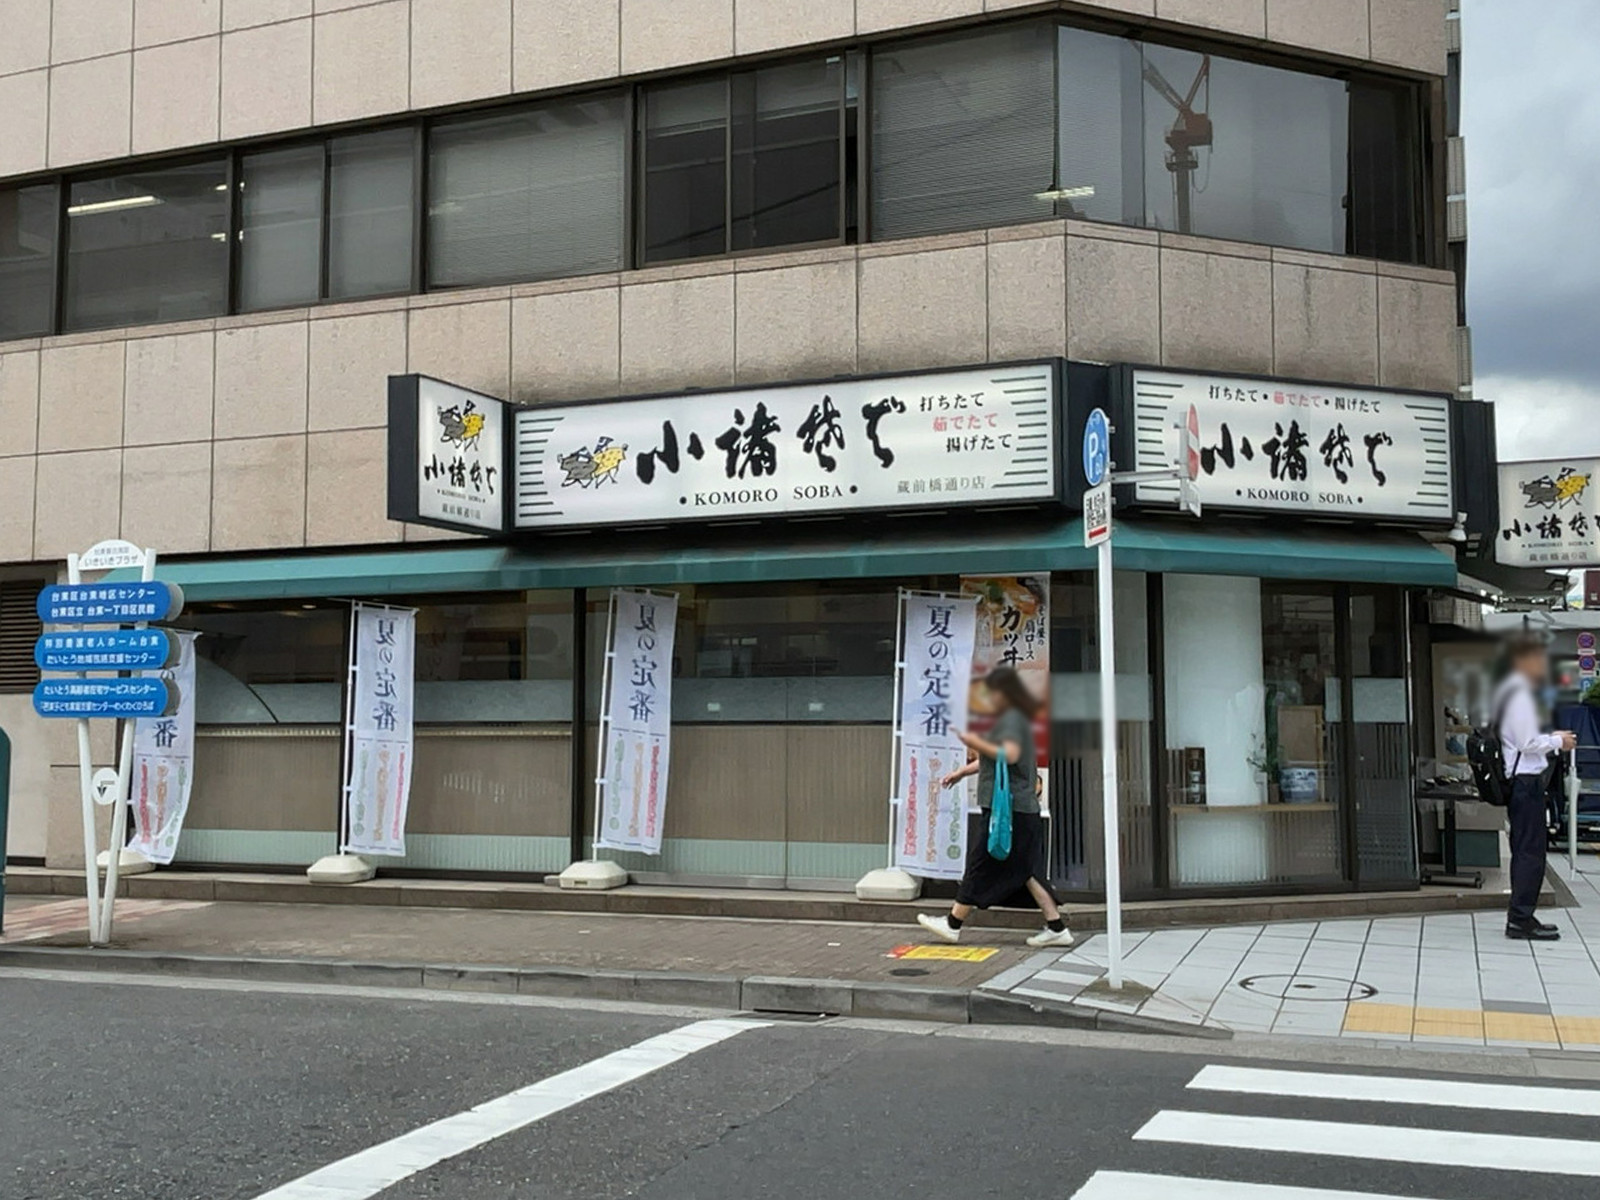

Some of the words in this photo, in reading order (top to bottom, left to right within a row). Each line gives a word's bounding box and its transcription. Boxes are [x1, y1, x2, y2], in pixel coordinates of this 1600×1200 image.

[920, 392, 985, 411] 打ちたて
[933, 413, 998, 432] 茹でたて
[946, 434, 1012, 452] 揚げたて
[897, 476, 985, 494] 蔵前橋通り店
[694, 490, 778, 507] KOMORO
[794, 483, 843, 500] SOBA
[1247, 488, 1309, 502] KOMORO
[1318, 492, 1353, 505] SOBA
[919, 604, 956, 737] 夏の定番
